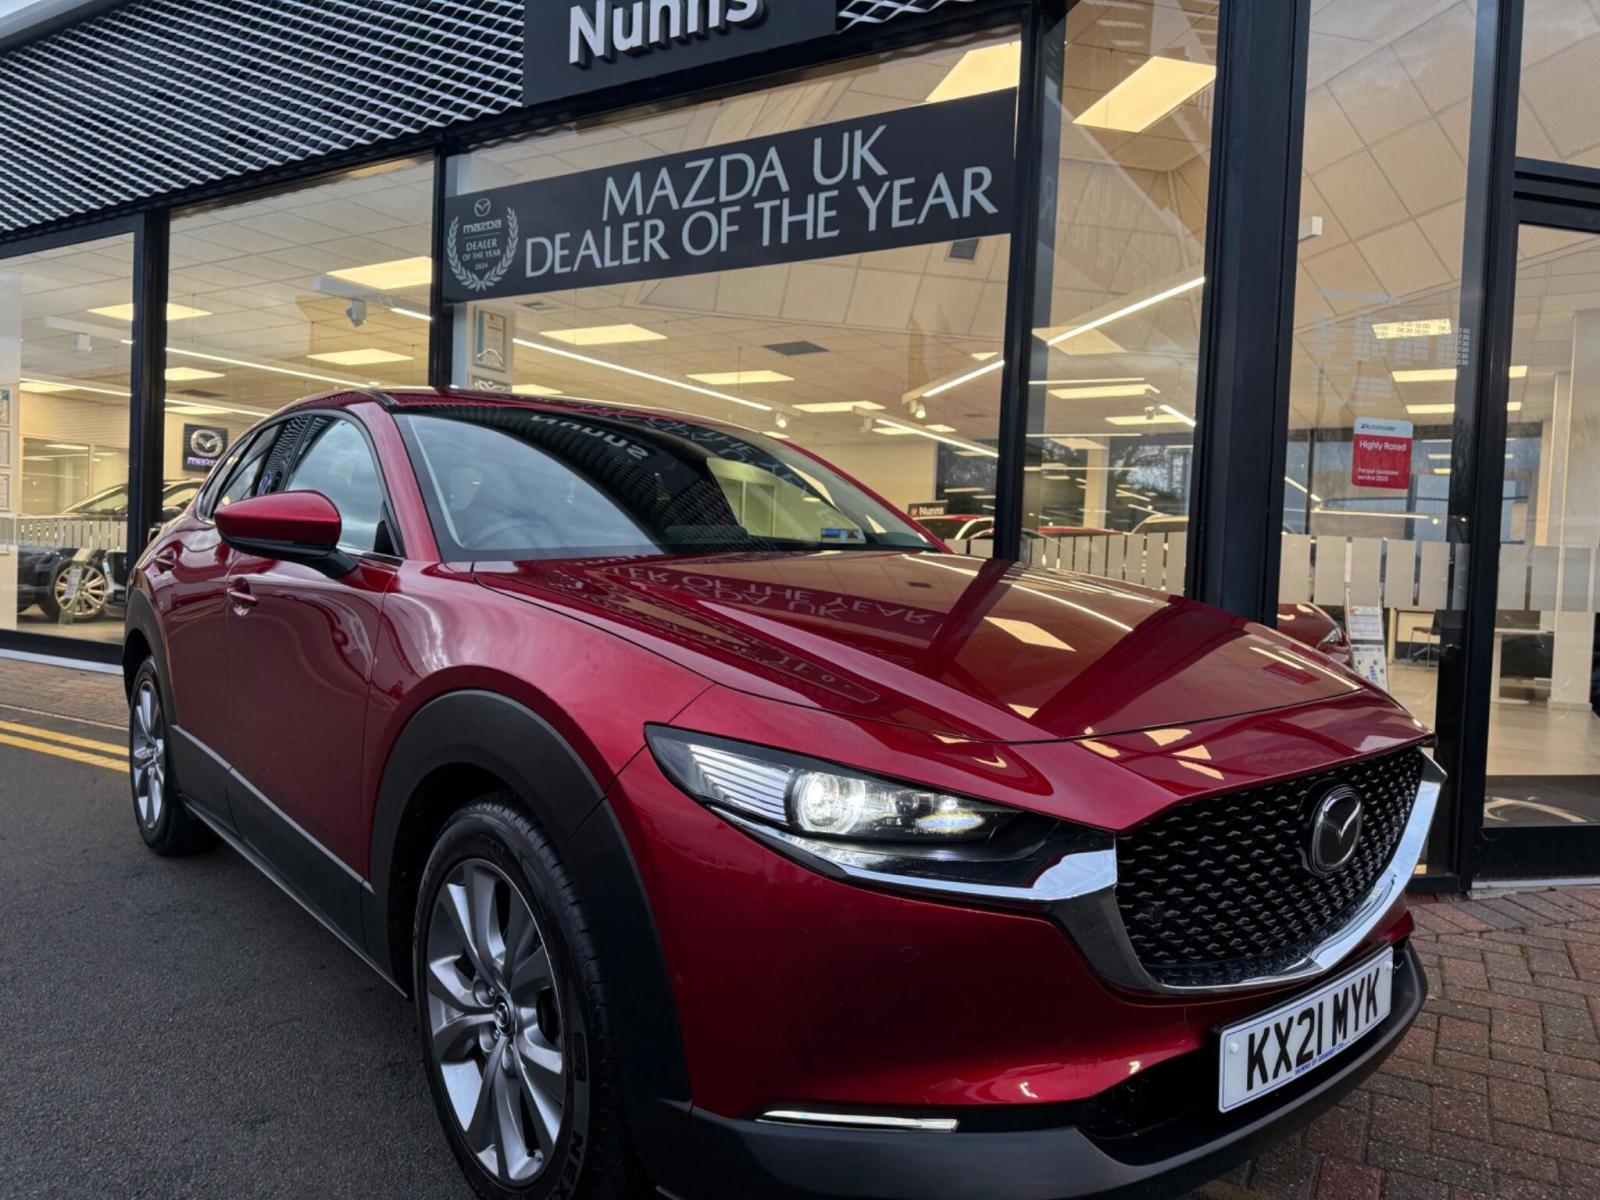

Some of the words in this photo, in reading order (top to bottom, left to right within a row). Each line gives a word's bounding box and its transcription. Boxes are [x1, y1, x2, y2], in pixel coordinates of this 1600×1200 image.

[602, 146, 790, 222] MAZDA
[812, 124, 888, 187] UK
[466, 239, 497, 251] DEALER
[524, 218, 671, 279] DEALER
[681, 210, 742, 257] OF
[754, 189, 840, 247] THE
[857, 165, 1000, 232] YEAR
[462, 253, 471, 262] OF
[472, 251, 484, 261] THE
[486, 249, 500, 258] YEAR
[1359, 440, 1383, 451] Highly
[1383, 441, 1407, 452] Rated
[1246, 1000, 1324, 1092] KX21
[1332, 967, 1380, 1047] MYK
